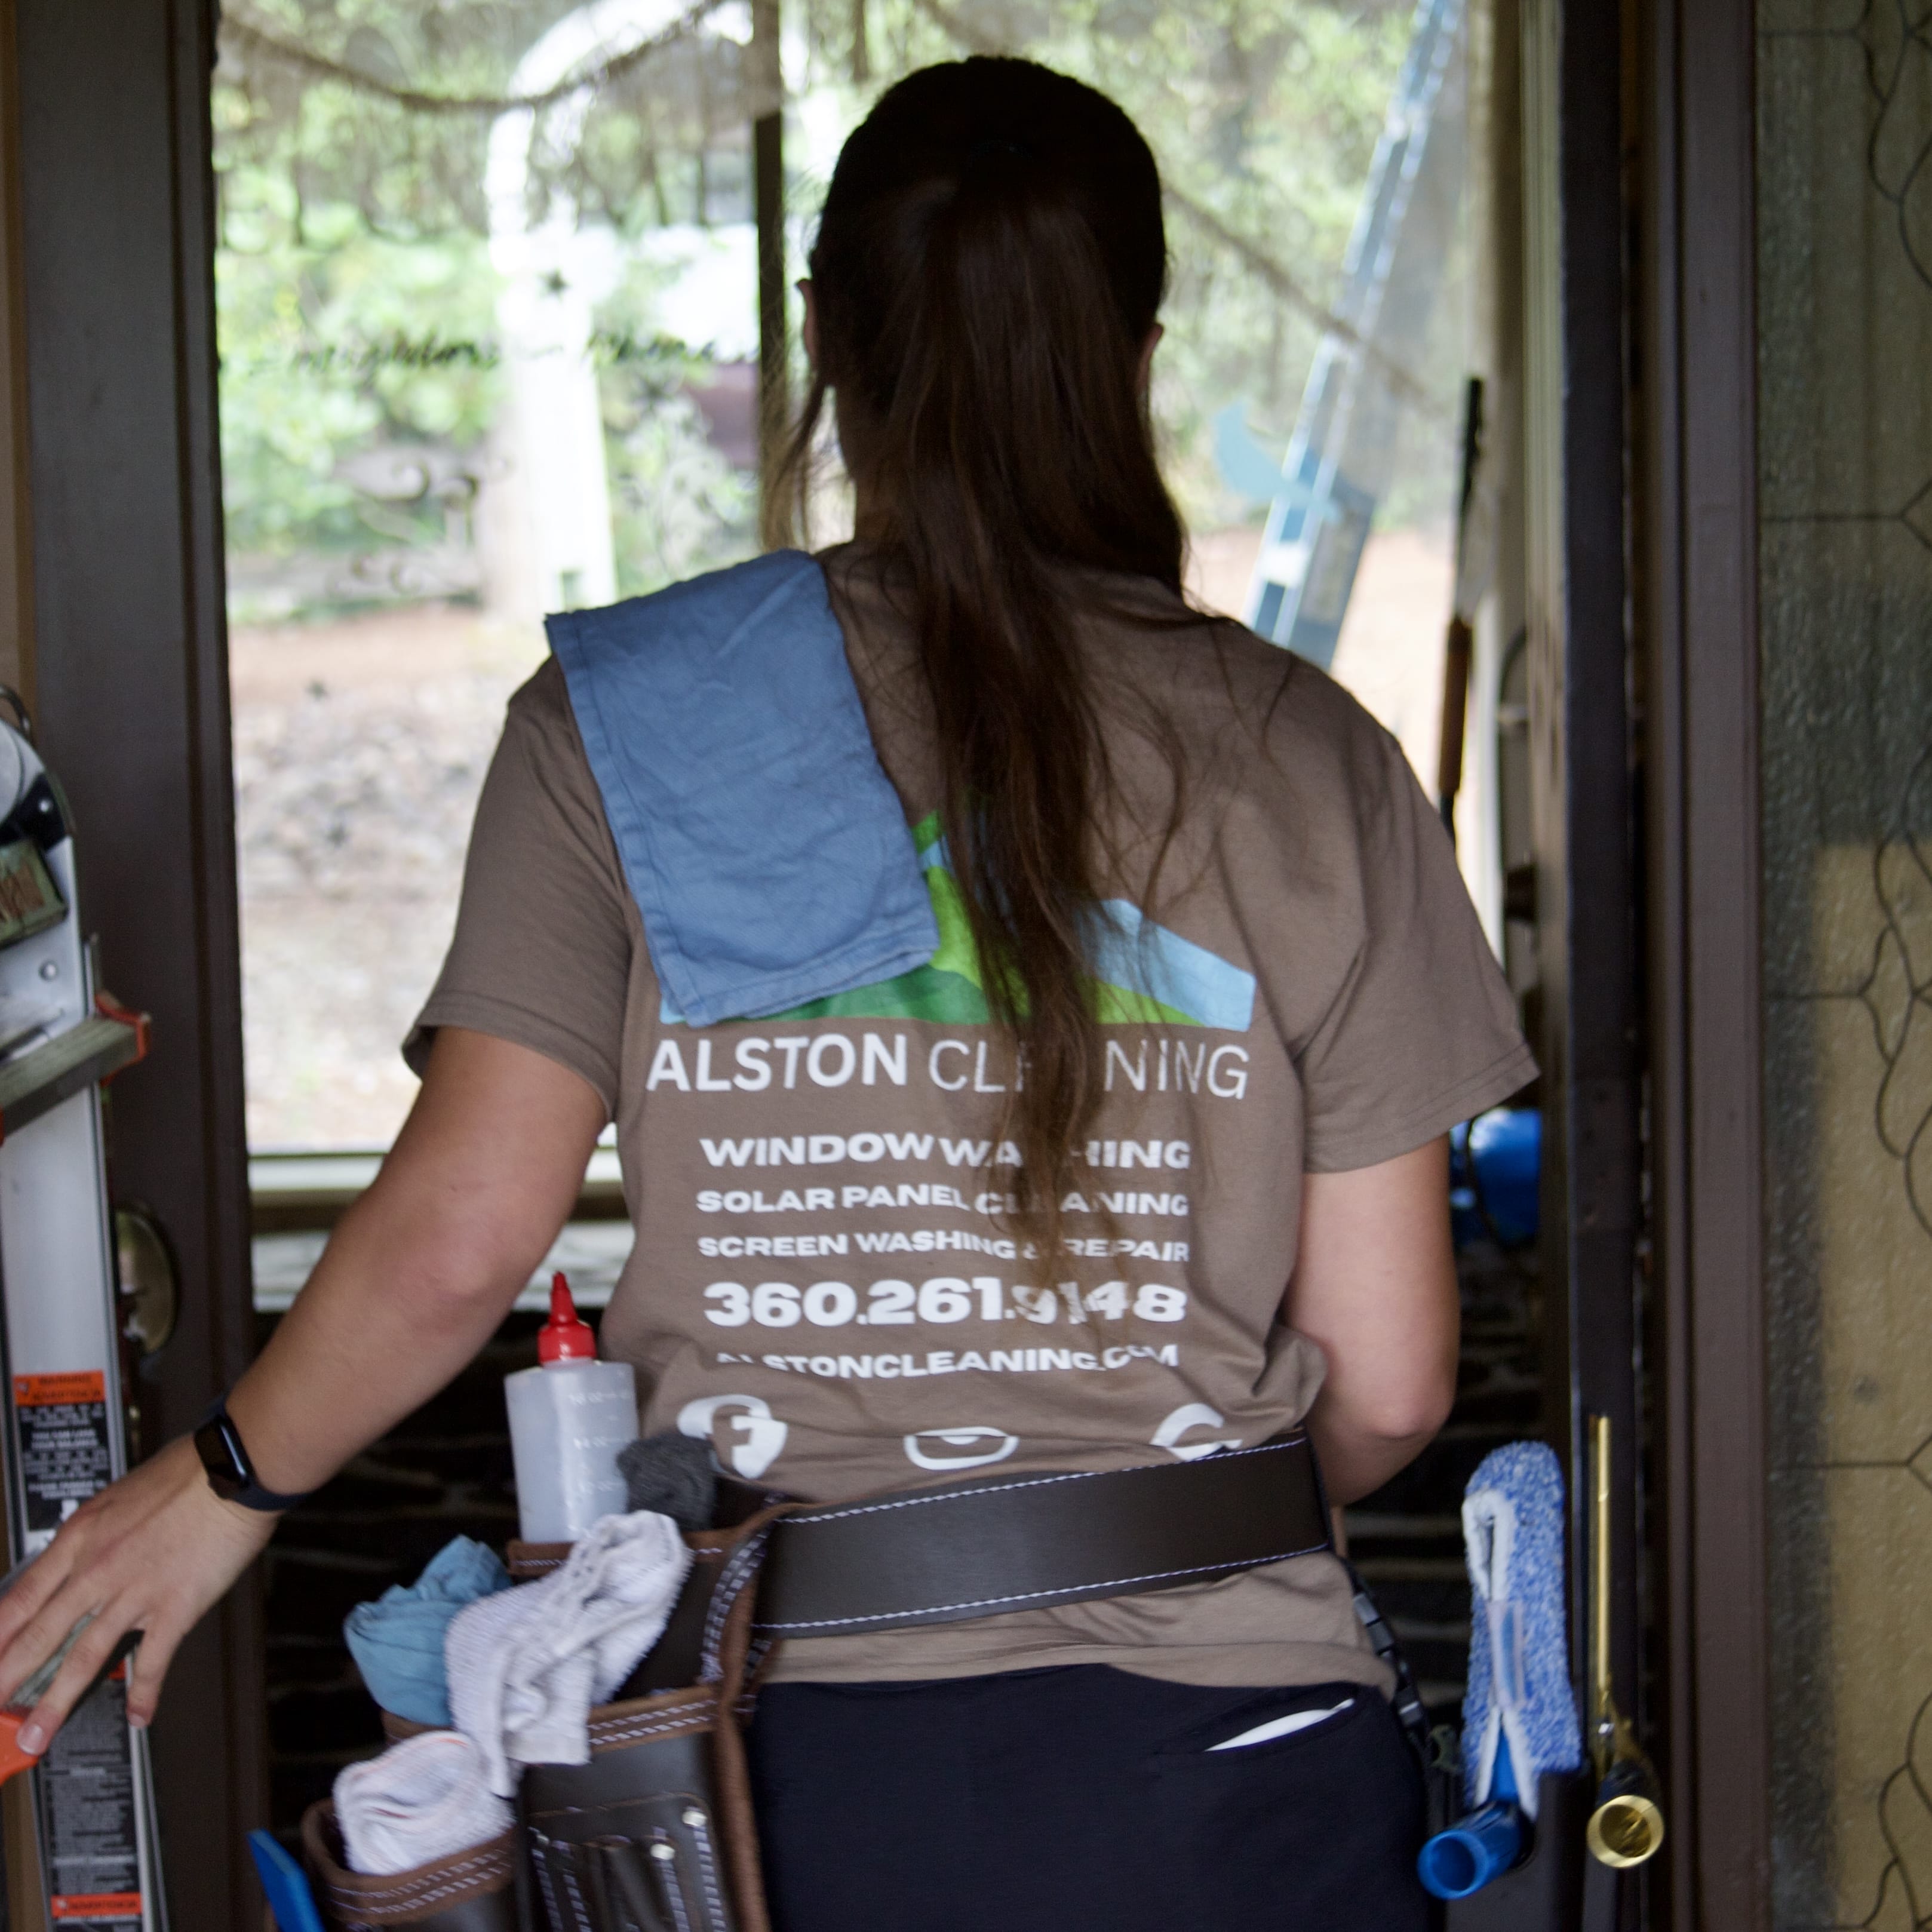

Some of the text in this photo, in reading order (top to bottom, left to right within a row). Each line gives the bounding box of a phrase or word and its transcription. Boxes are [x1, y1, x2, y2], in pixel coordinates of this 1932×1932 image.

[646, 1033, 907, 1091] ALSTON
[699, 1134, 934, 1166] WINDOW
[695, 1189, 835, 1214] SOLAR
[841, 1185, 970, 1211] PANEL
[698, 1234, 849, 1258] SCREEN
[853, 1231, 1016, 1260] WASHING
[704, 1277, 1187, 1327] 360.261.9148
